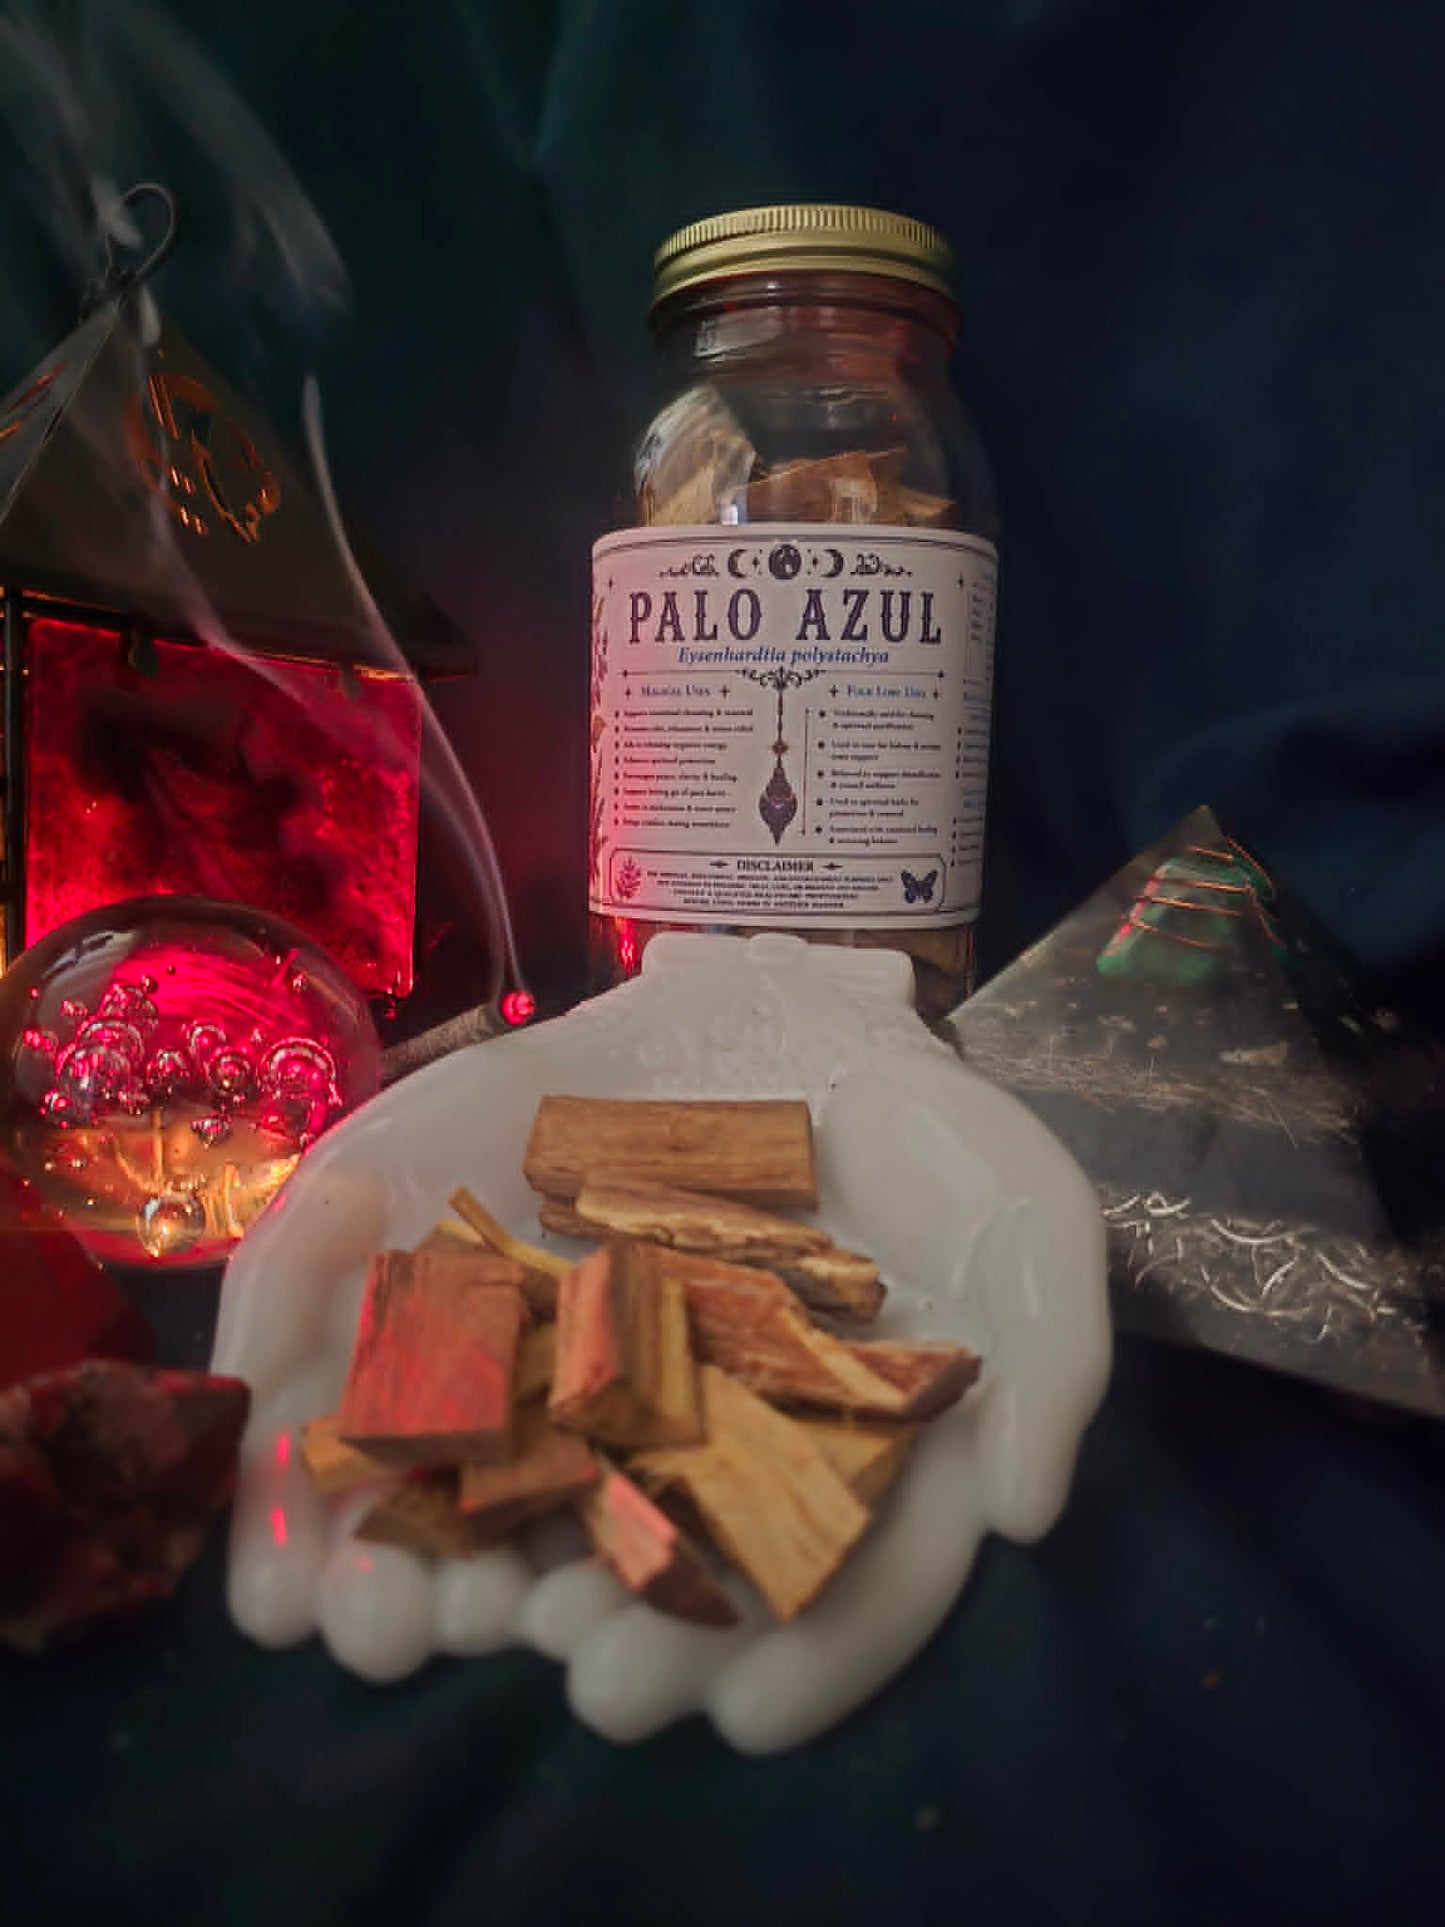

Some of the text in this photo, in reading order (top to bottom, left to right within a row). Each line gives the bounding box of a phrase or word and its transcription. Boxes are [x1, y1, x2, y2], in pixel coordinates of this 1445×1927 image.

[628, 588, 762, 644] PALO
[795, 588, 942, 644] AZUL
[790, 647, 889, 667] polystachya
[737, 859, 814, 872] DISCLAIMER
